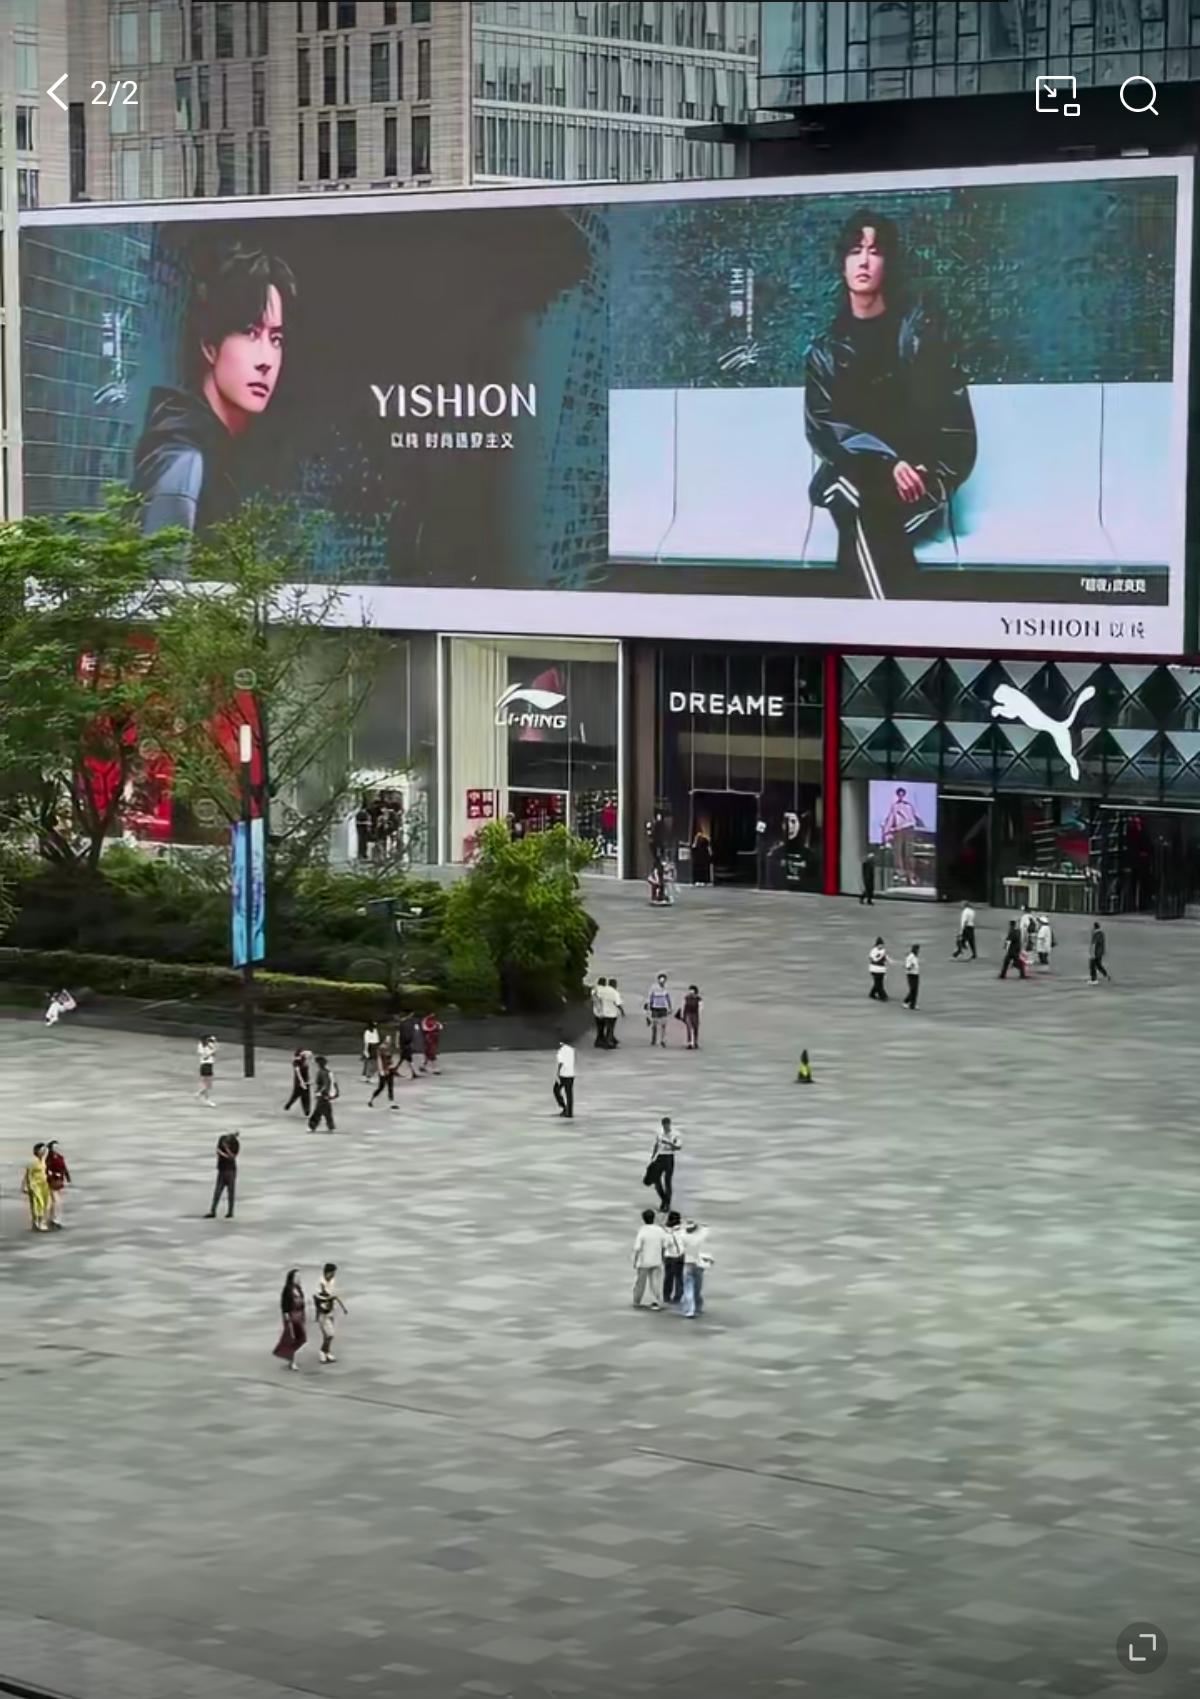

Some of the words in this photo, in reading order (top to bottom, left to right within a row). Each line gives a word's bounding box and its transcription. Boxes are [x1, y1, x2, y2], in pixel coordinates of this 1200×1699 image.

[370, 383, 536, 417] YISHION
[1000, 617, 1099, 637] YISHION
[669, 691, 783, 716] DREAME
